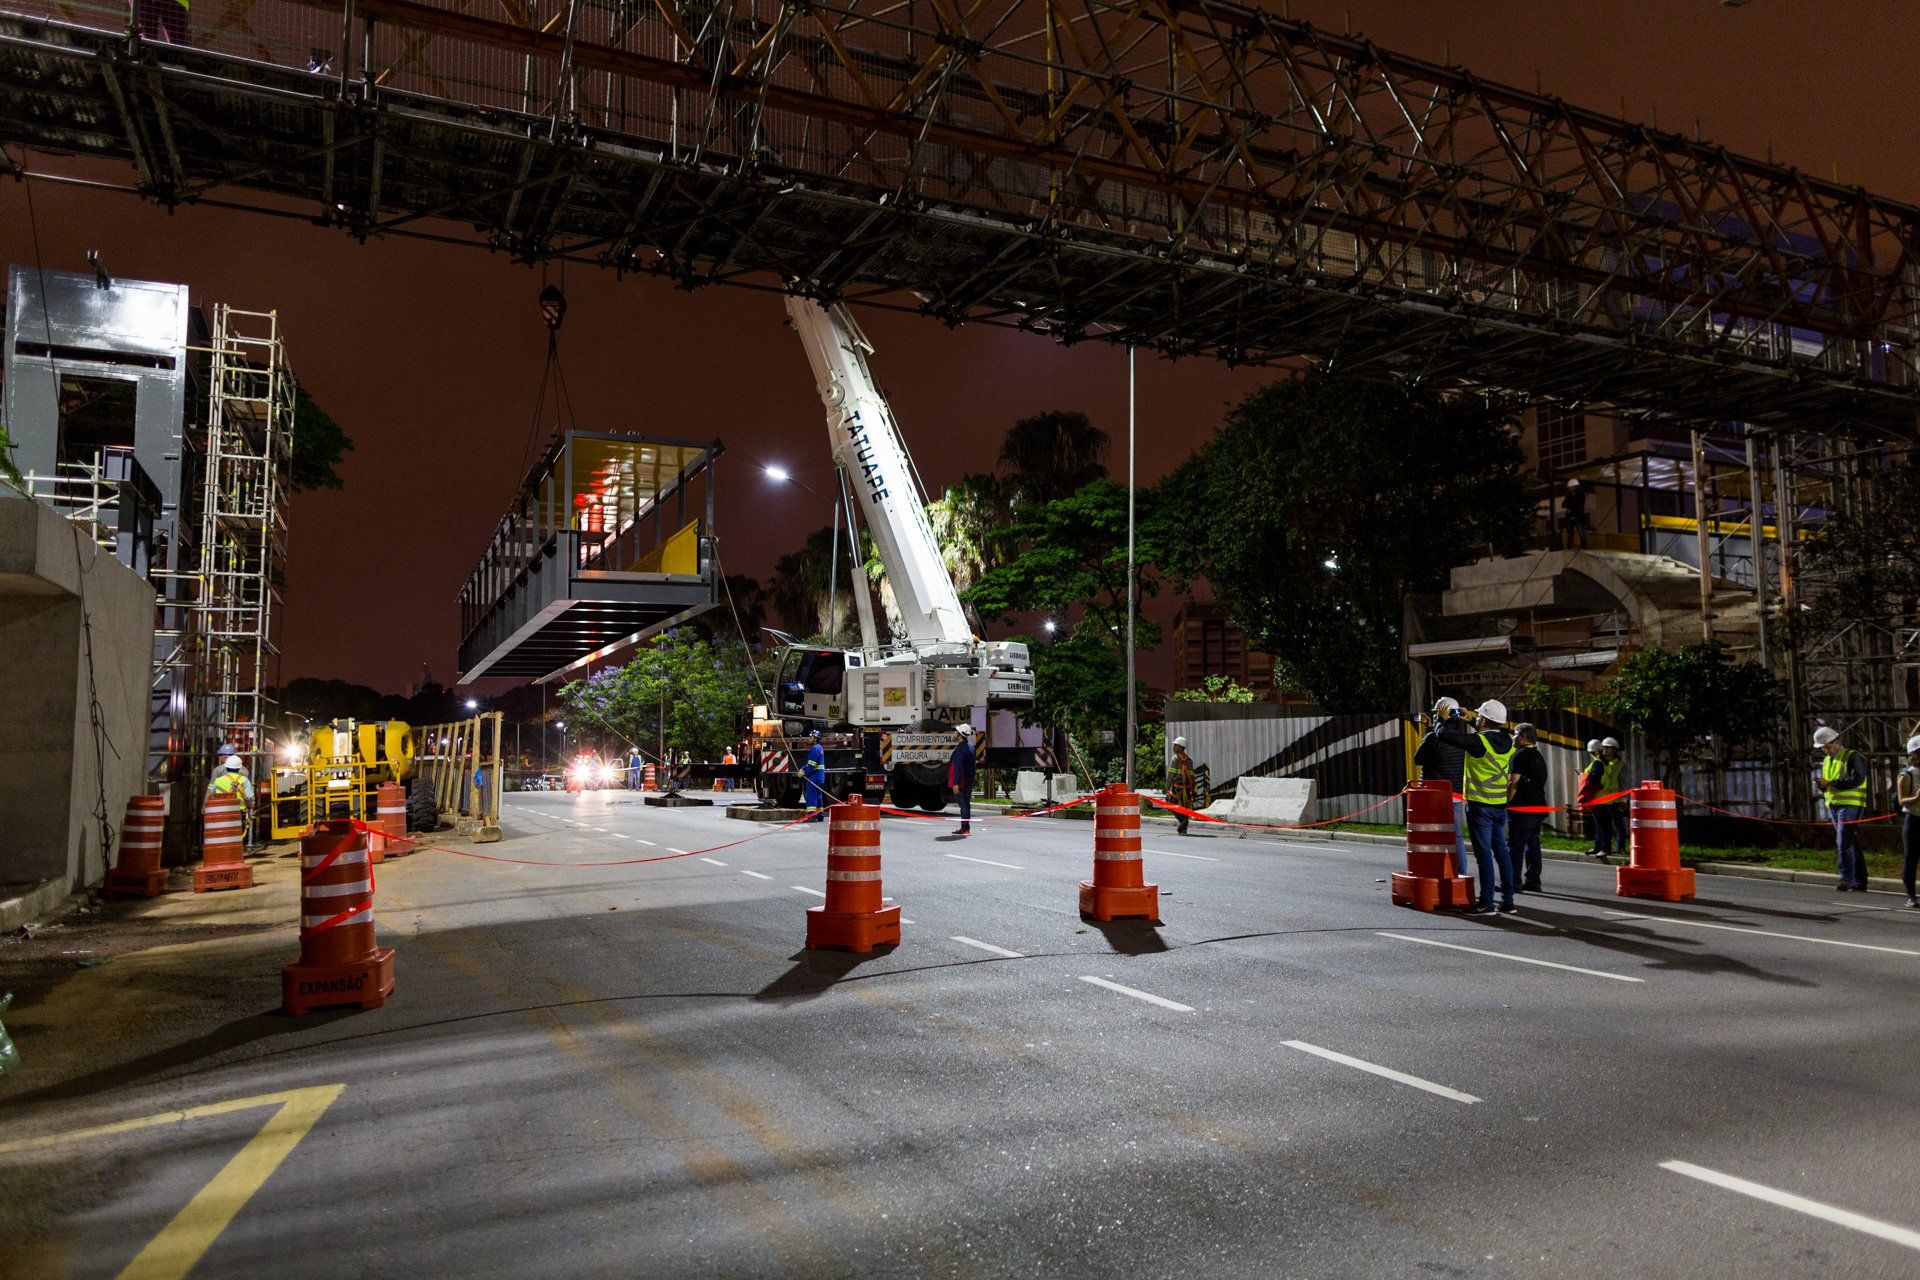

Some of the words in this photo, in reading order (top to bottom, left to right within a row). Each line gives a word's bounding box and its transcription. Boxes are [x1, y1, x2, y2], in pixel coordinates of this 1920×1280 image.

[828, 705, 840, 715] 100
[896, 735, 944, 744] COMPRIMENTO
[896, 752, 928, 760] LARGURA
[298, 975, 364, 996] EXPANSÃO
